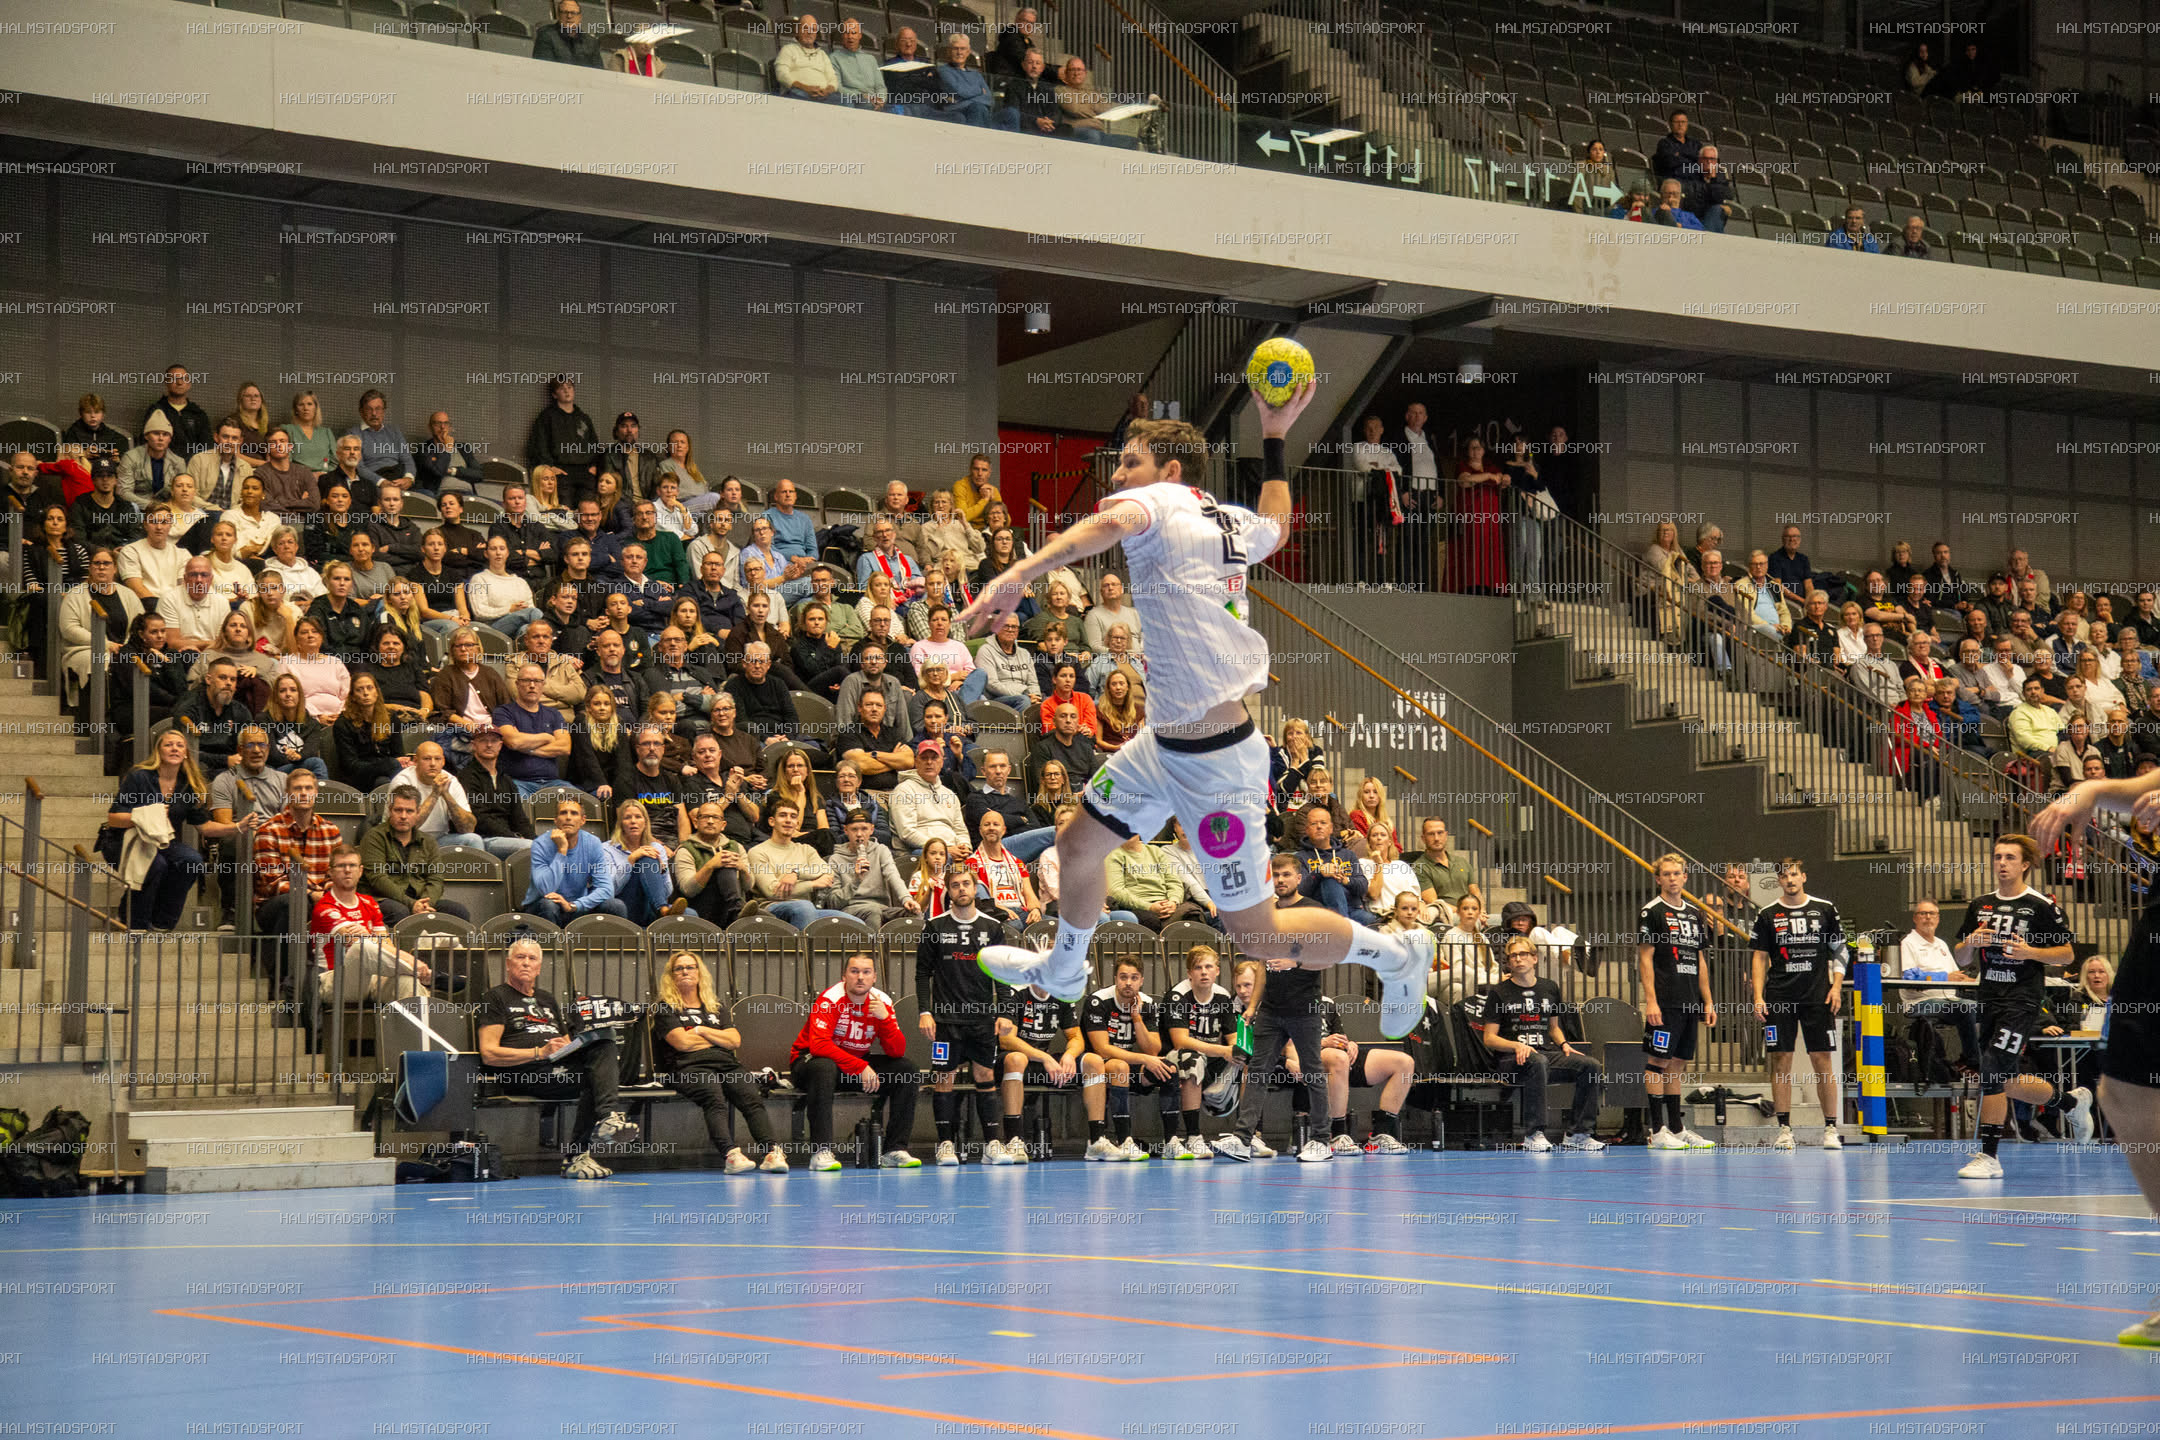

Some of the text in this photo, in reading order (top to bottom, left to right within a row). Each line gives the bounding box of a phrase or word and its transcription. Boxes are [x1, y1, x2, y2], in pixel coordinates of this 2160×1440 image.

[1350, 713, 1446, 751] Arena
[1221, 860, 1247, 890] 26
[196, 913, 205, 926] L
[1991, 914, 2014, 935] 33
[961, 931, 970, 945] 5
[593, 999, 611, 1019] 15
[849, 1020, 865, 1040] 16
[1034, 1012, 1044, 1030] 2
[1197, 1016, 1210, 1035] 11
[1993, 1028, 2023, 1054] 33
